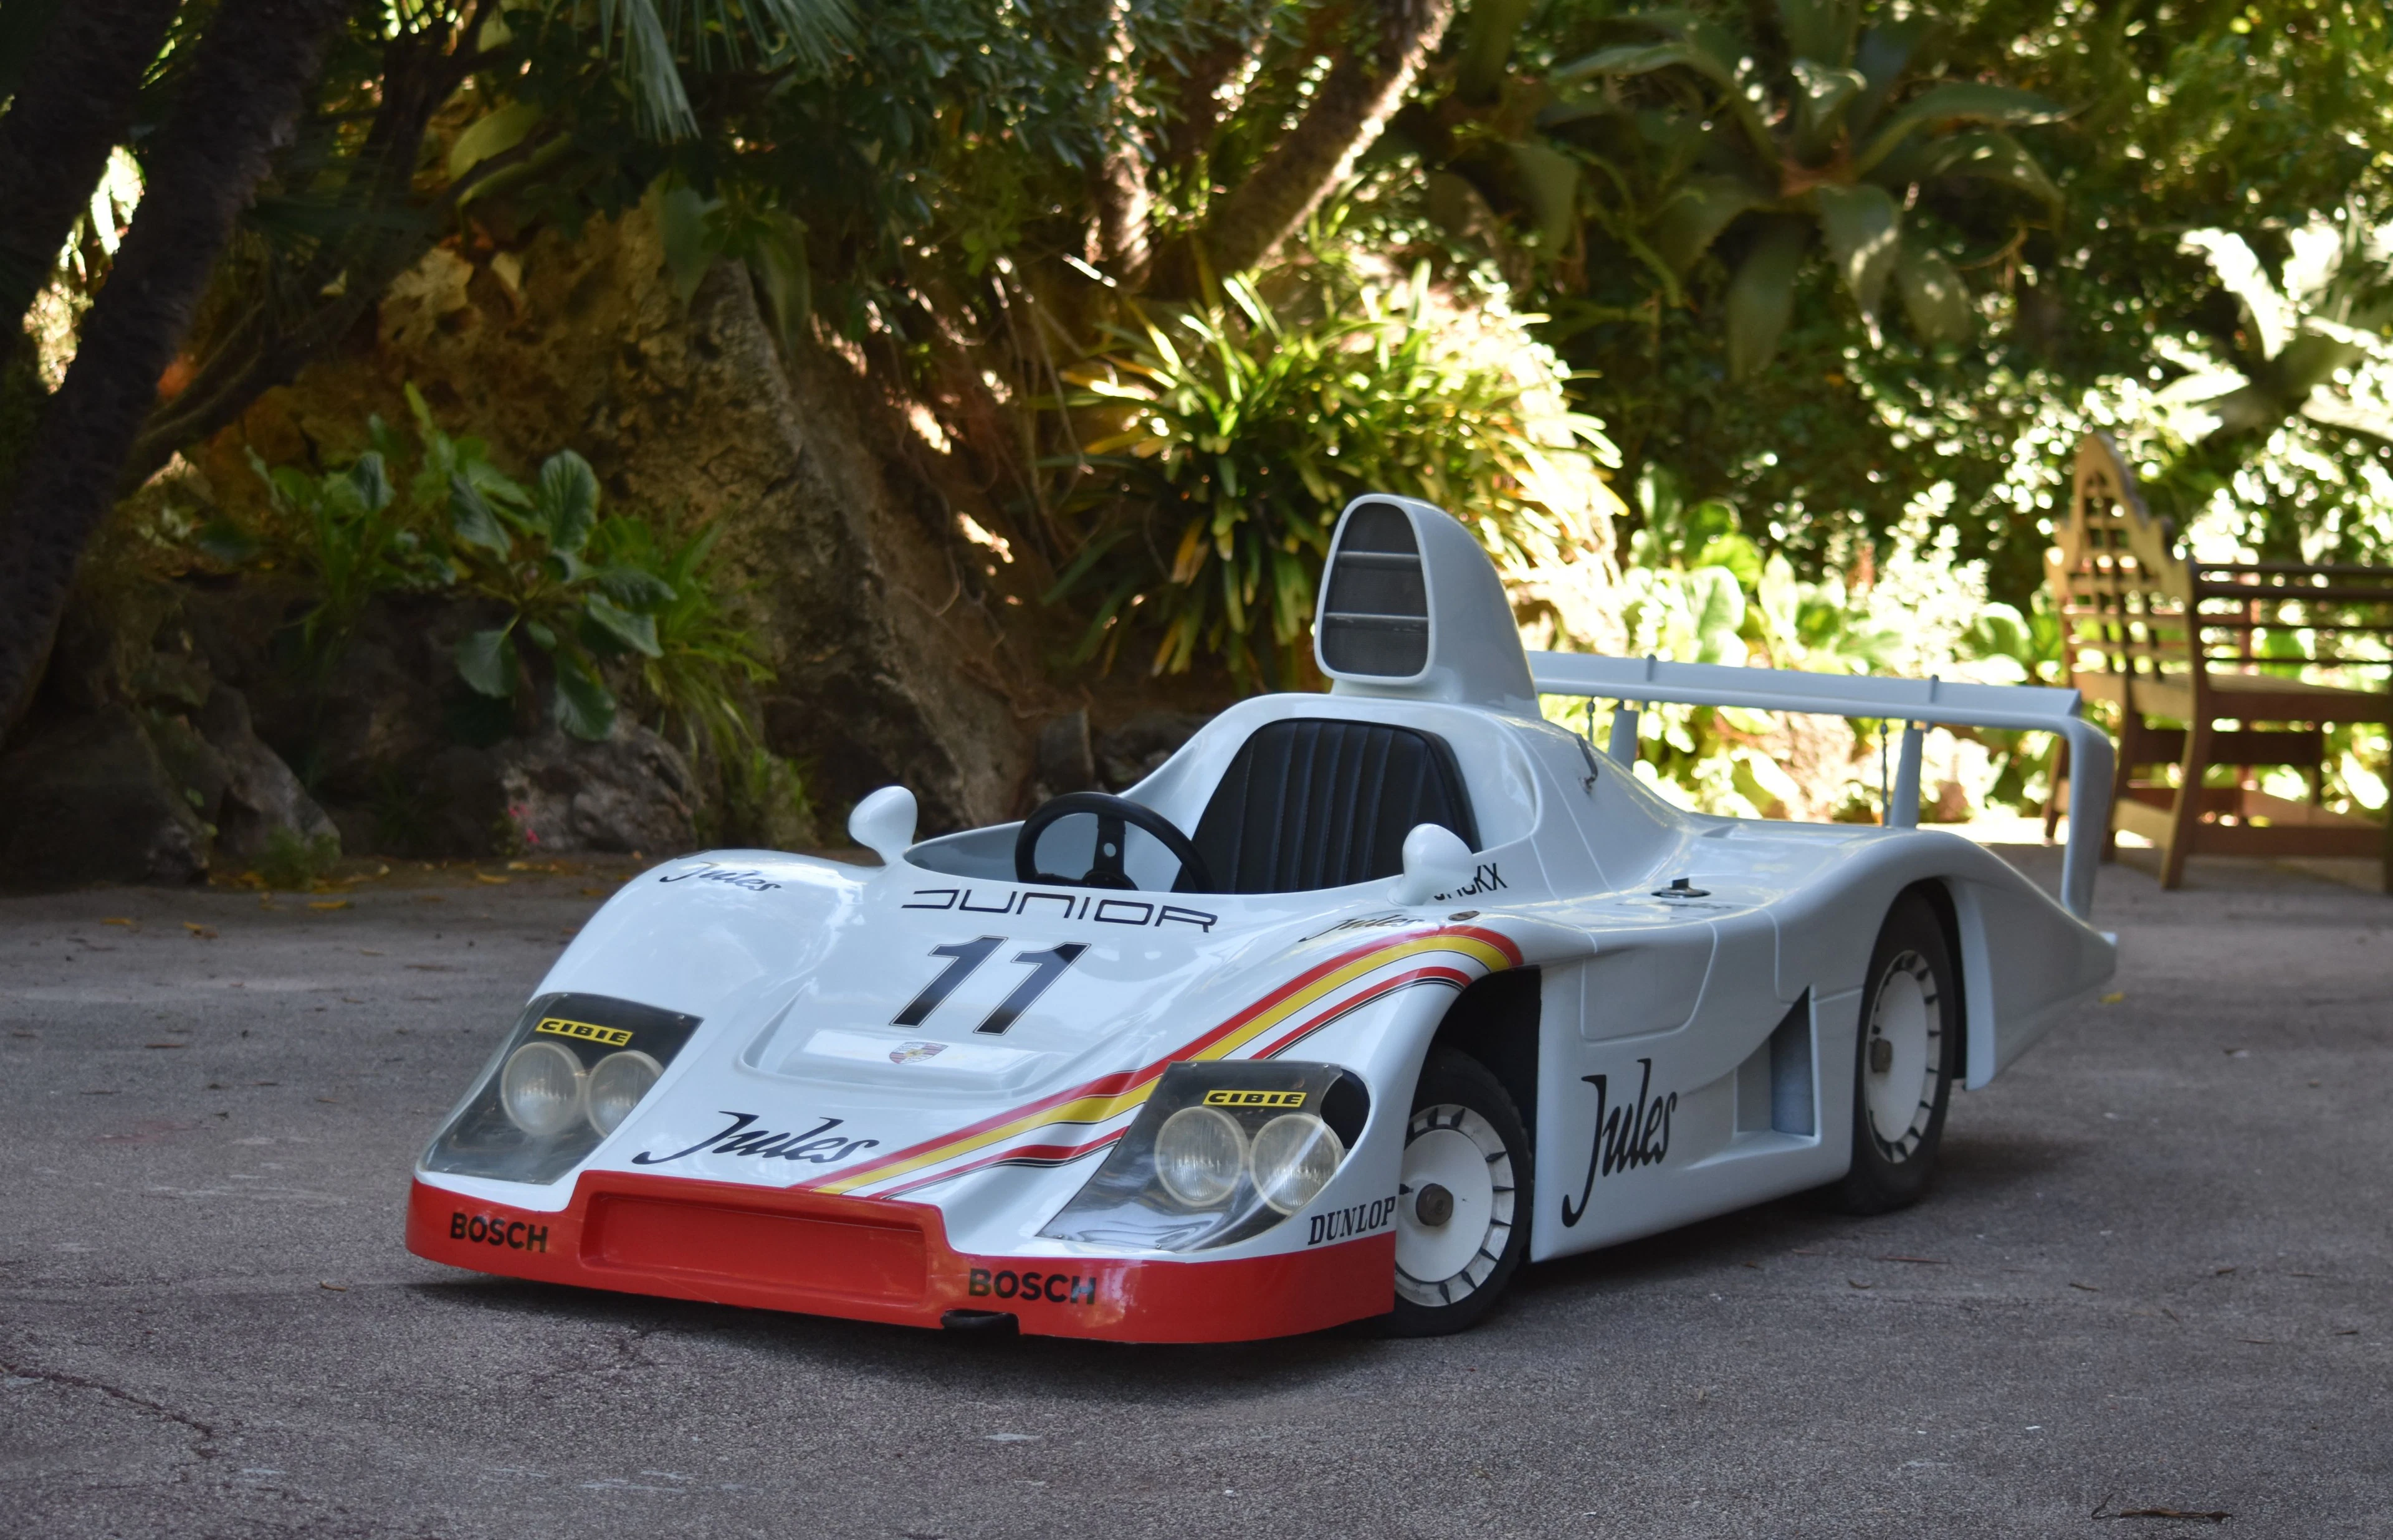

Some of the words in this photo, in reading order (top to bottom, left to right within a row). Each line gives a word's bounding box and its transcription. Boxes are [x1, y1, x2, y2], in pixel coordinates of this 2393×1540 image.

[659, 862, 781, 891] Jules
[901, 889, 1218, 933] JUNIOR
[1298, 915, 1425, 943] Jules
[889, 934, 1091, 1036] 11
[632, 1111, 880, 1164] Jules
[1561, 1058, 1678, 1227] Jules
[450, 1212, 548, 1253] BOSCH
[1307, 1196, 1396, 1245] DUNLOP
[968, 1268, 1097, 1305] BOSCH
